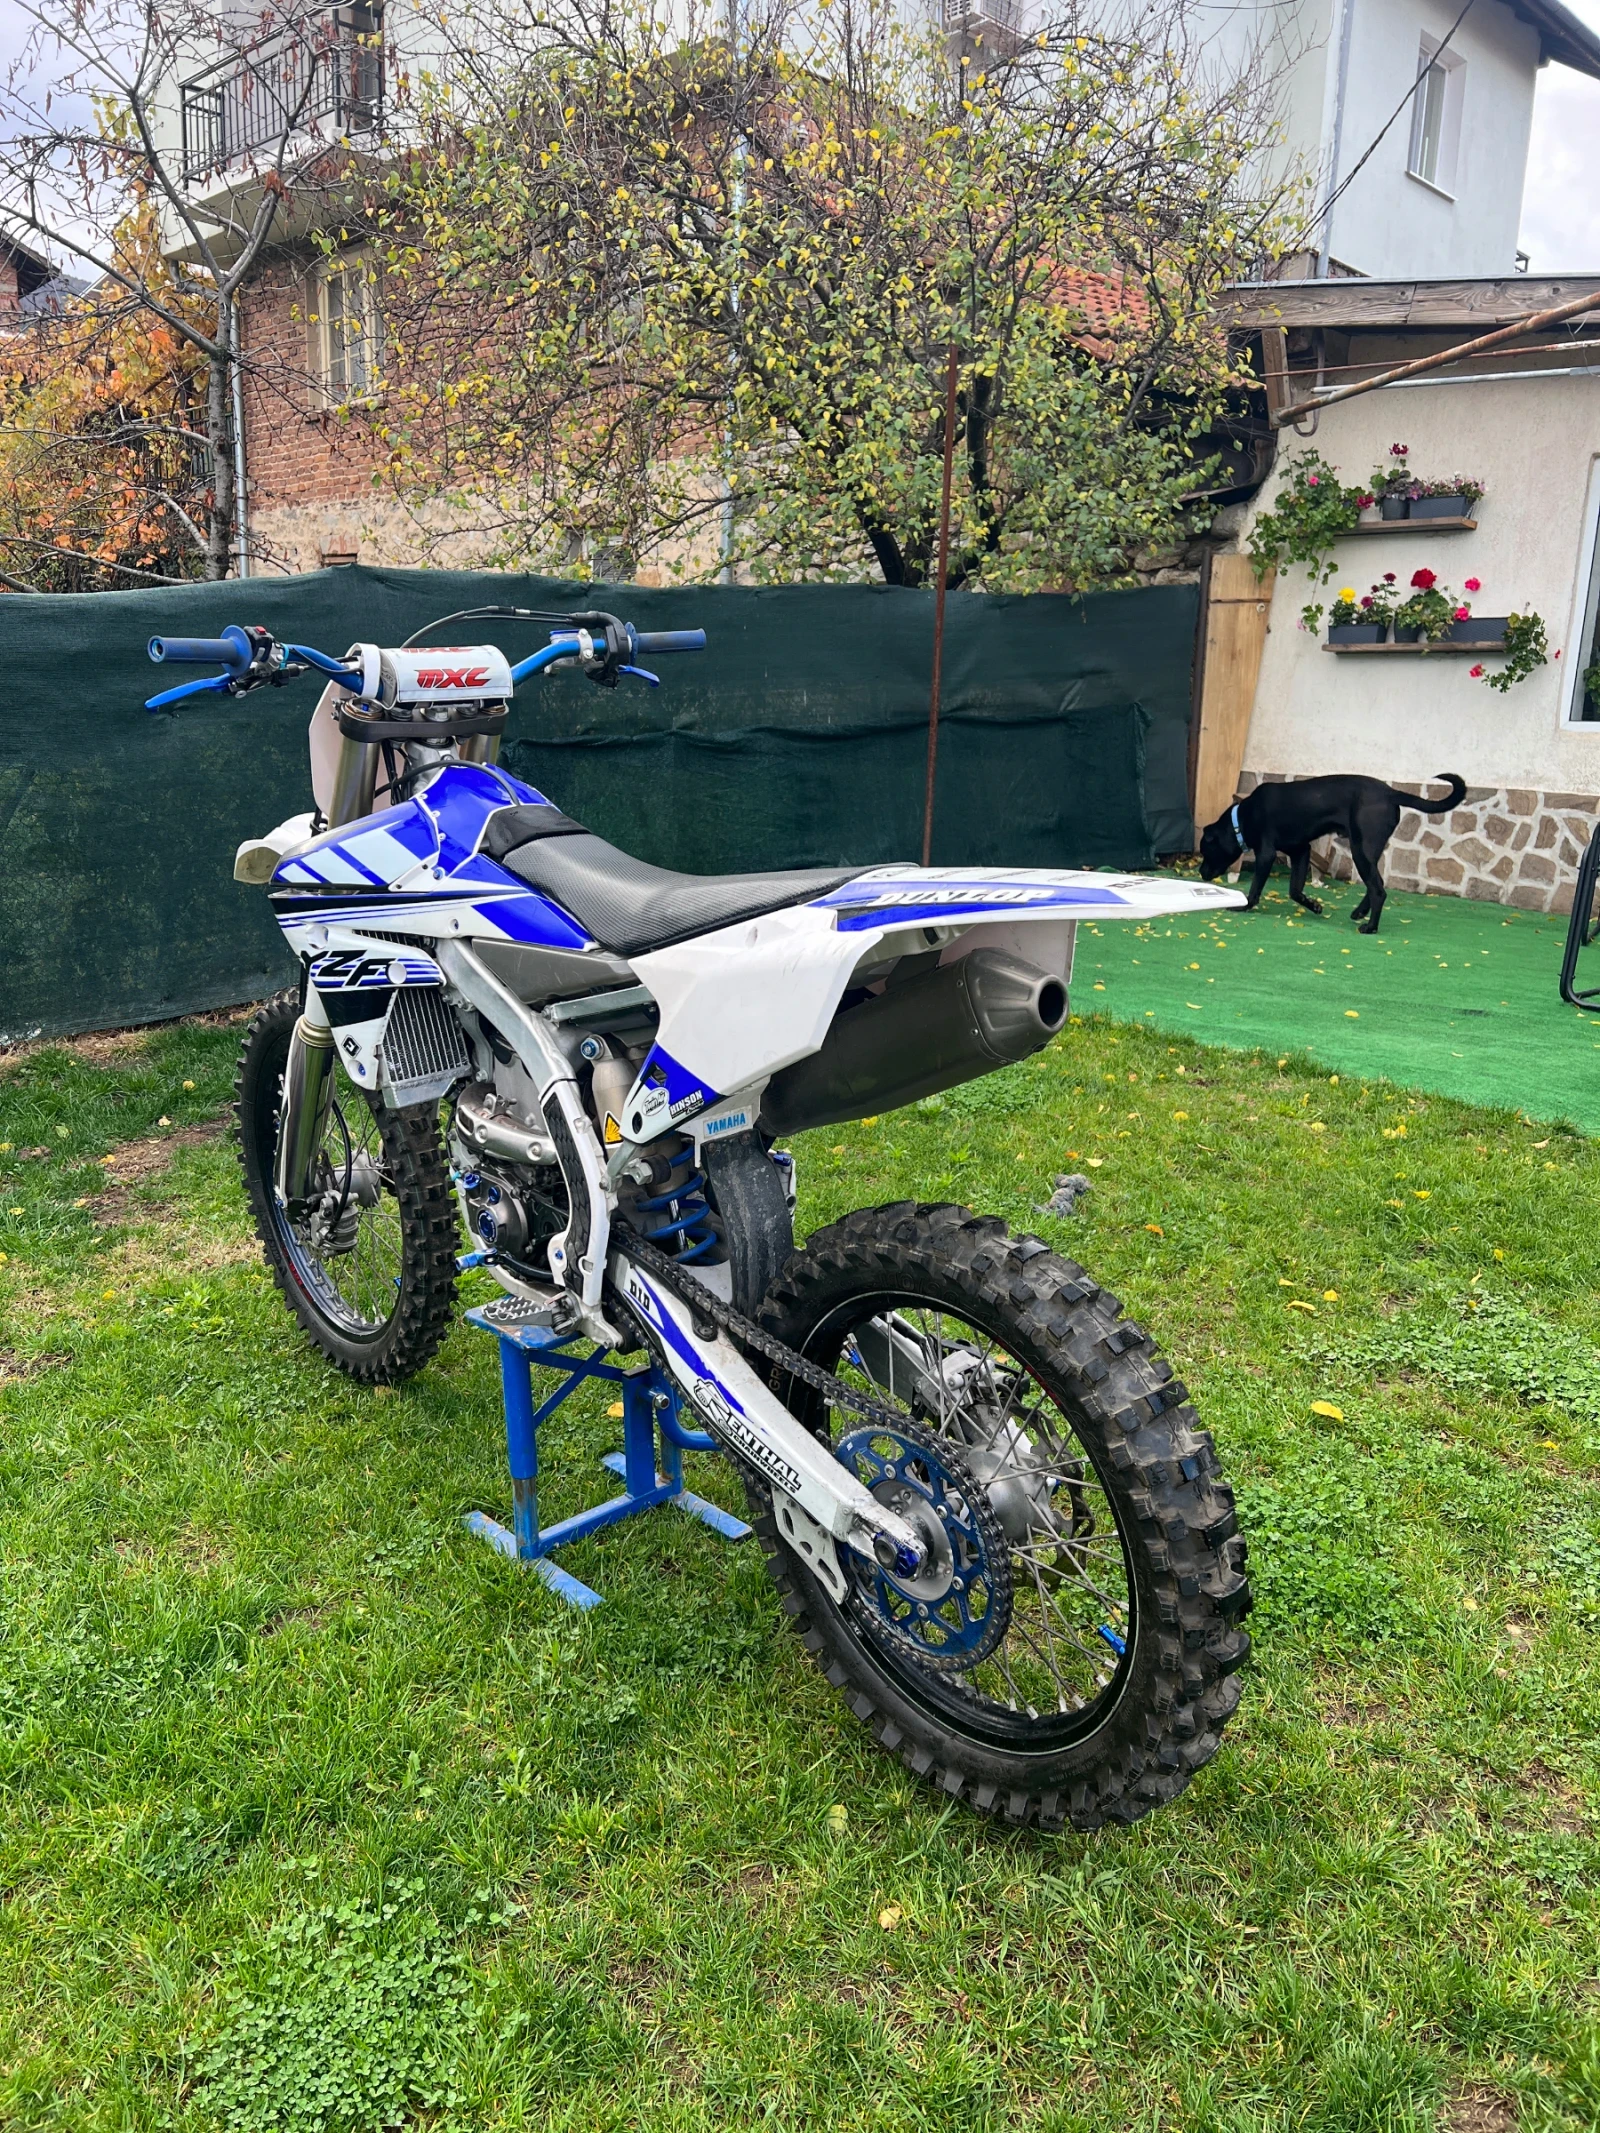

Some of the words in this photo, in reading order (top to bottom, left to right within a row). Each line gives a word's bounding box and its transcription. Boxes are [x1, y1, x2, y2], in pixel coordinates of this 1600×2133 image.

[414, 667, 491, 688] MXC
[866, 889, 1055, 906] DUNLOP
[301, 950, 396, 986] YZF
[669, 1089, 703, 1118] HINSON
[706, 1112, 746, 1135] YAMAHA
[630, 1280, 651, 1311] DID
[769, 1365, 784, 1391] GRI
[694, 1379, 802, 1487] RENTHAL
